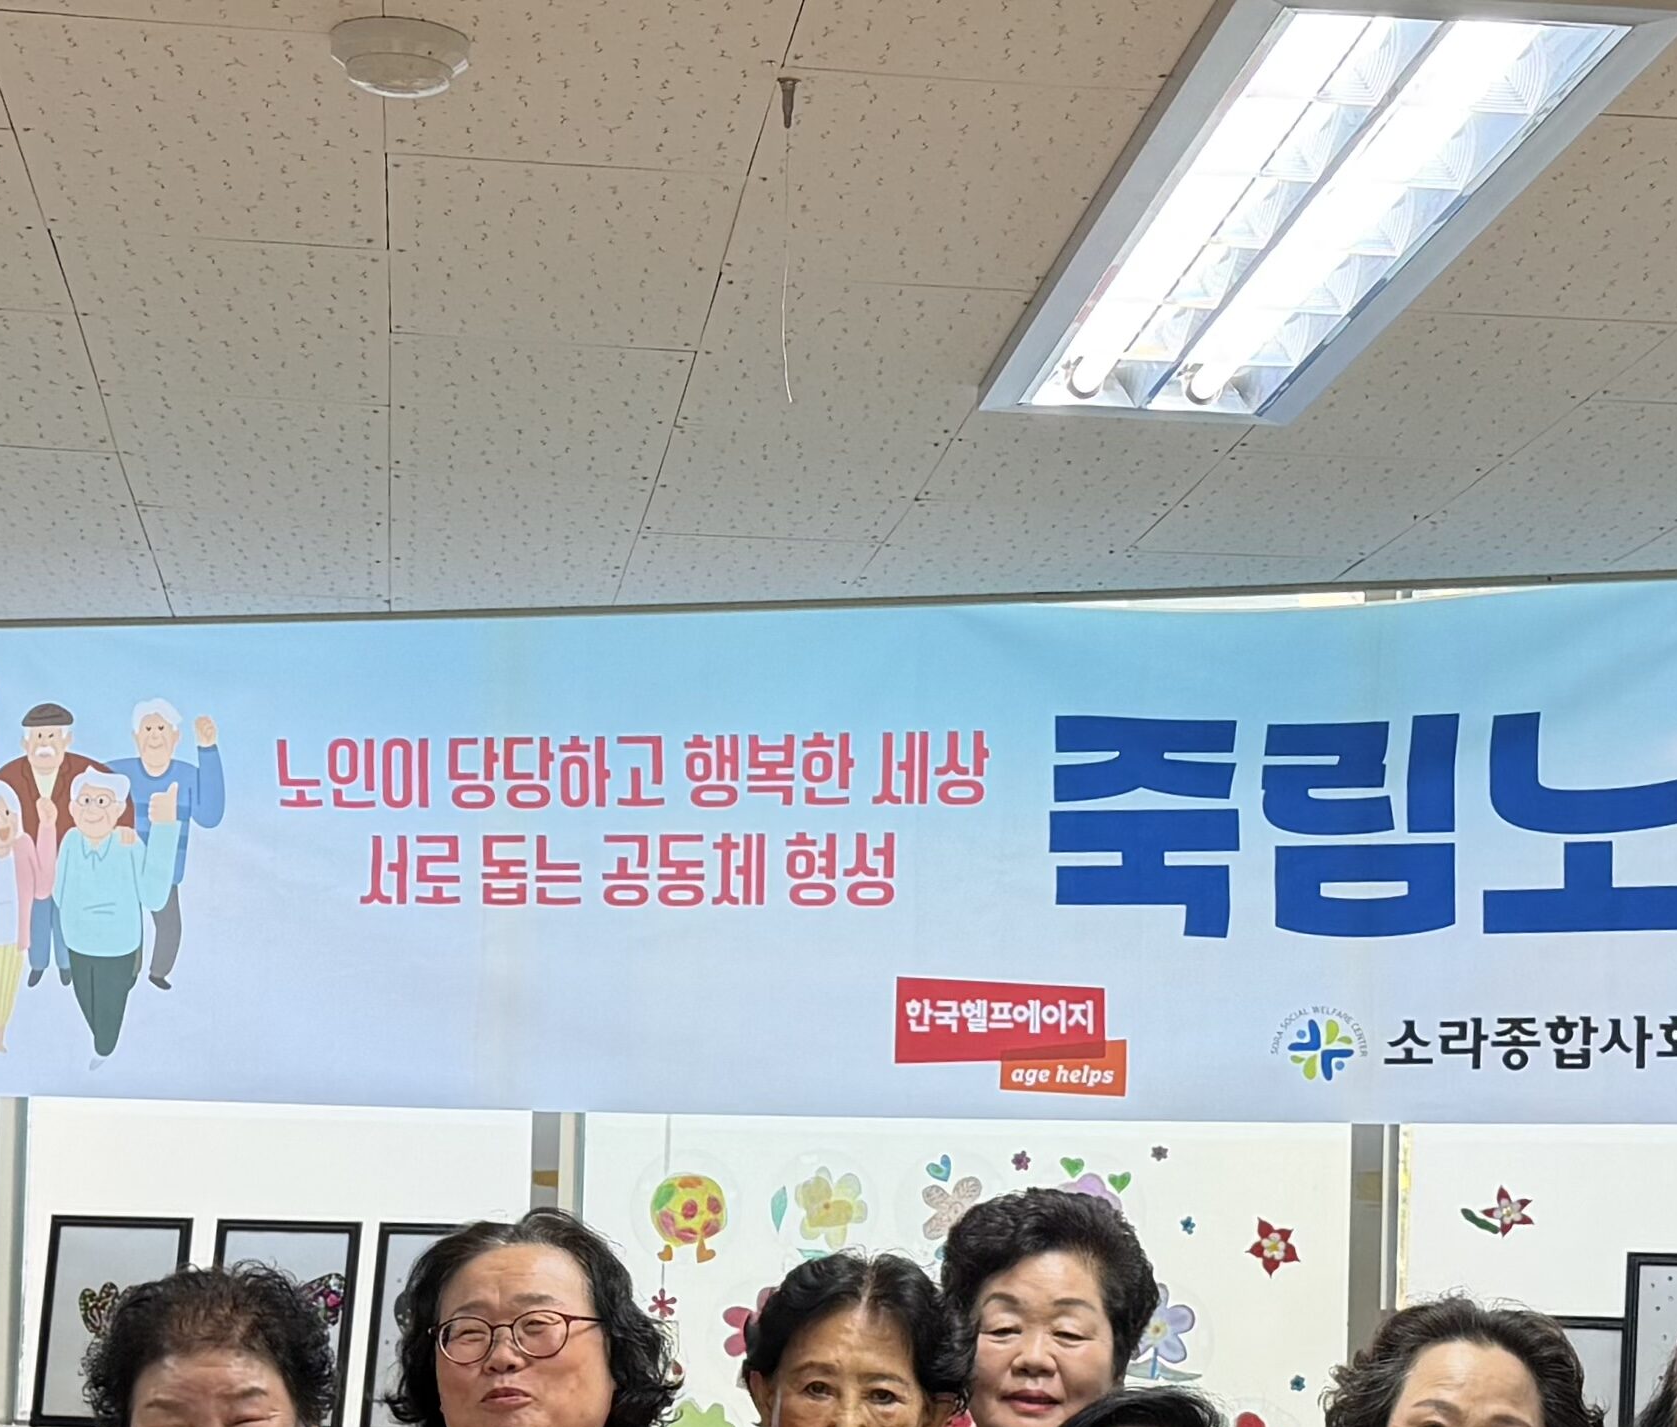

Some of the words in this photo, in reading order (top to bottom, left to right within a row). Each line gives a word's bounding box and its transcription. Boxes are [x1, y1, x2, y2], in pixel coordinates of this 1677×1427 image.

[277, 738, 429, 808] 노인이
[449, 736, 664, 809] 당당하고
[684, 732, 854, 807] 행복한
[872, 731, 989, 805] 세상
[360, 835, 460, 904] 서로
[481, 835, 582, 905] 돕는
[602, 833, 765, 906] 공동체
[786, 832, 894, 906] 형성
[905, 998, 1094, 1035] 한국헬프에이지
[1282, 1008, 1309, 1029] SOCIAL
[1311, 1006, 1353, 1025] WELFARE
[1350, 1023, 1369, 1058] CENTER
[1011, 1066, 1049, 1087] age
[1055, 1064, 1114, 1088] helps
